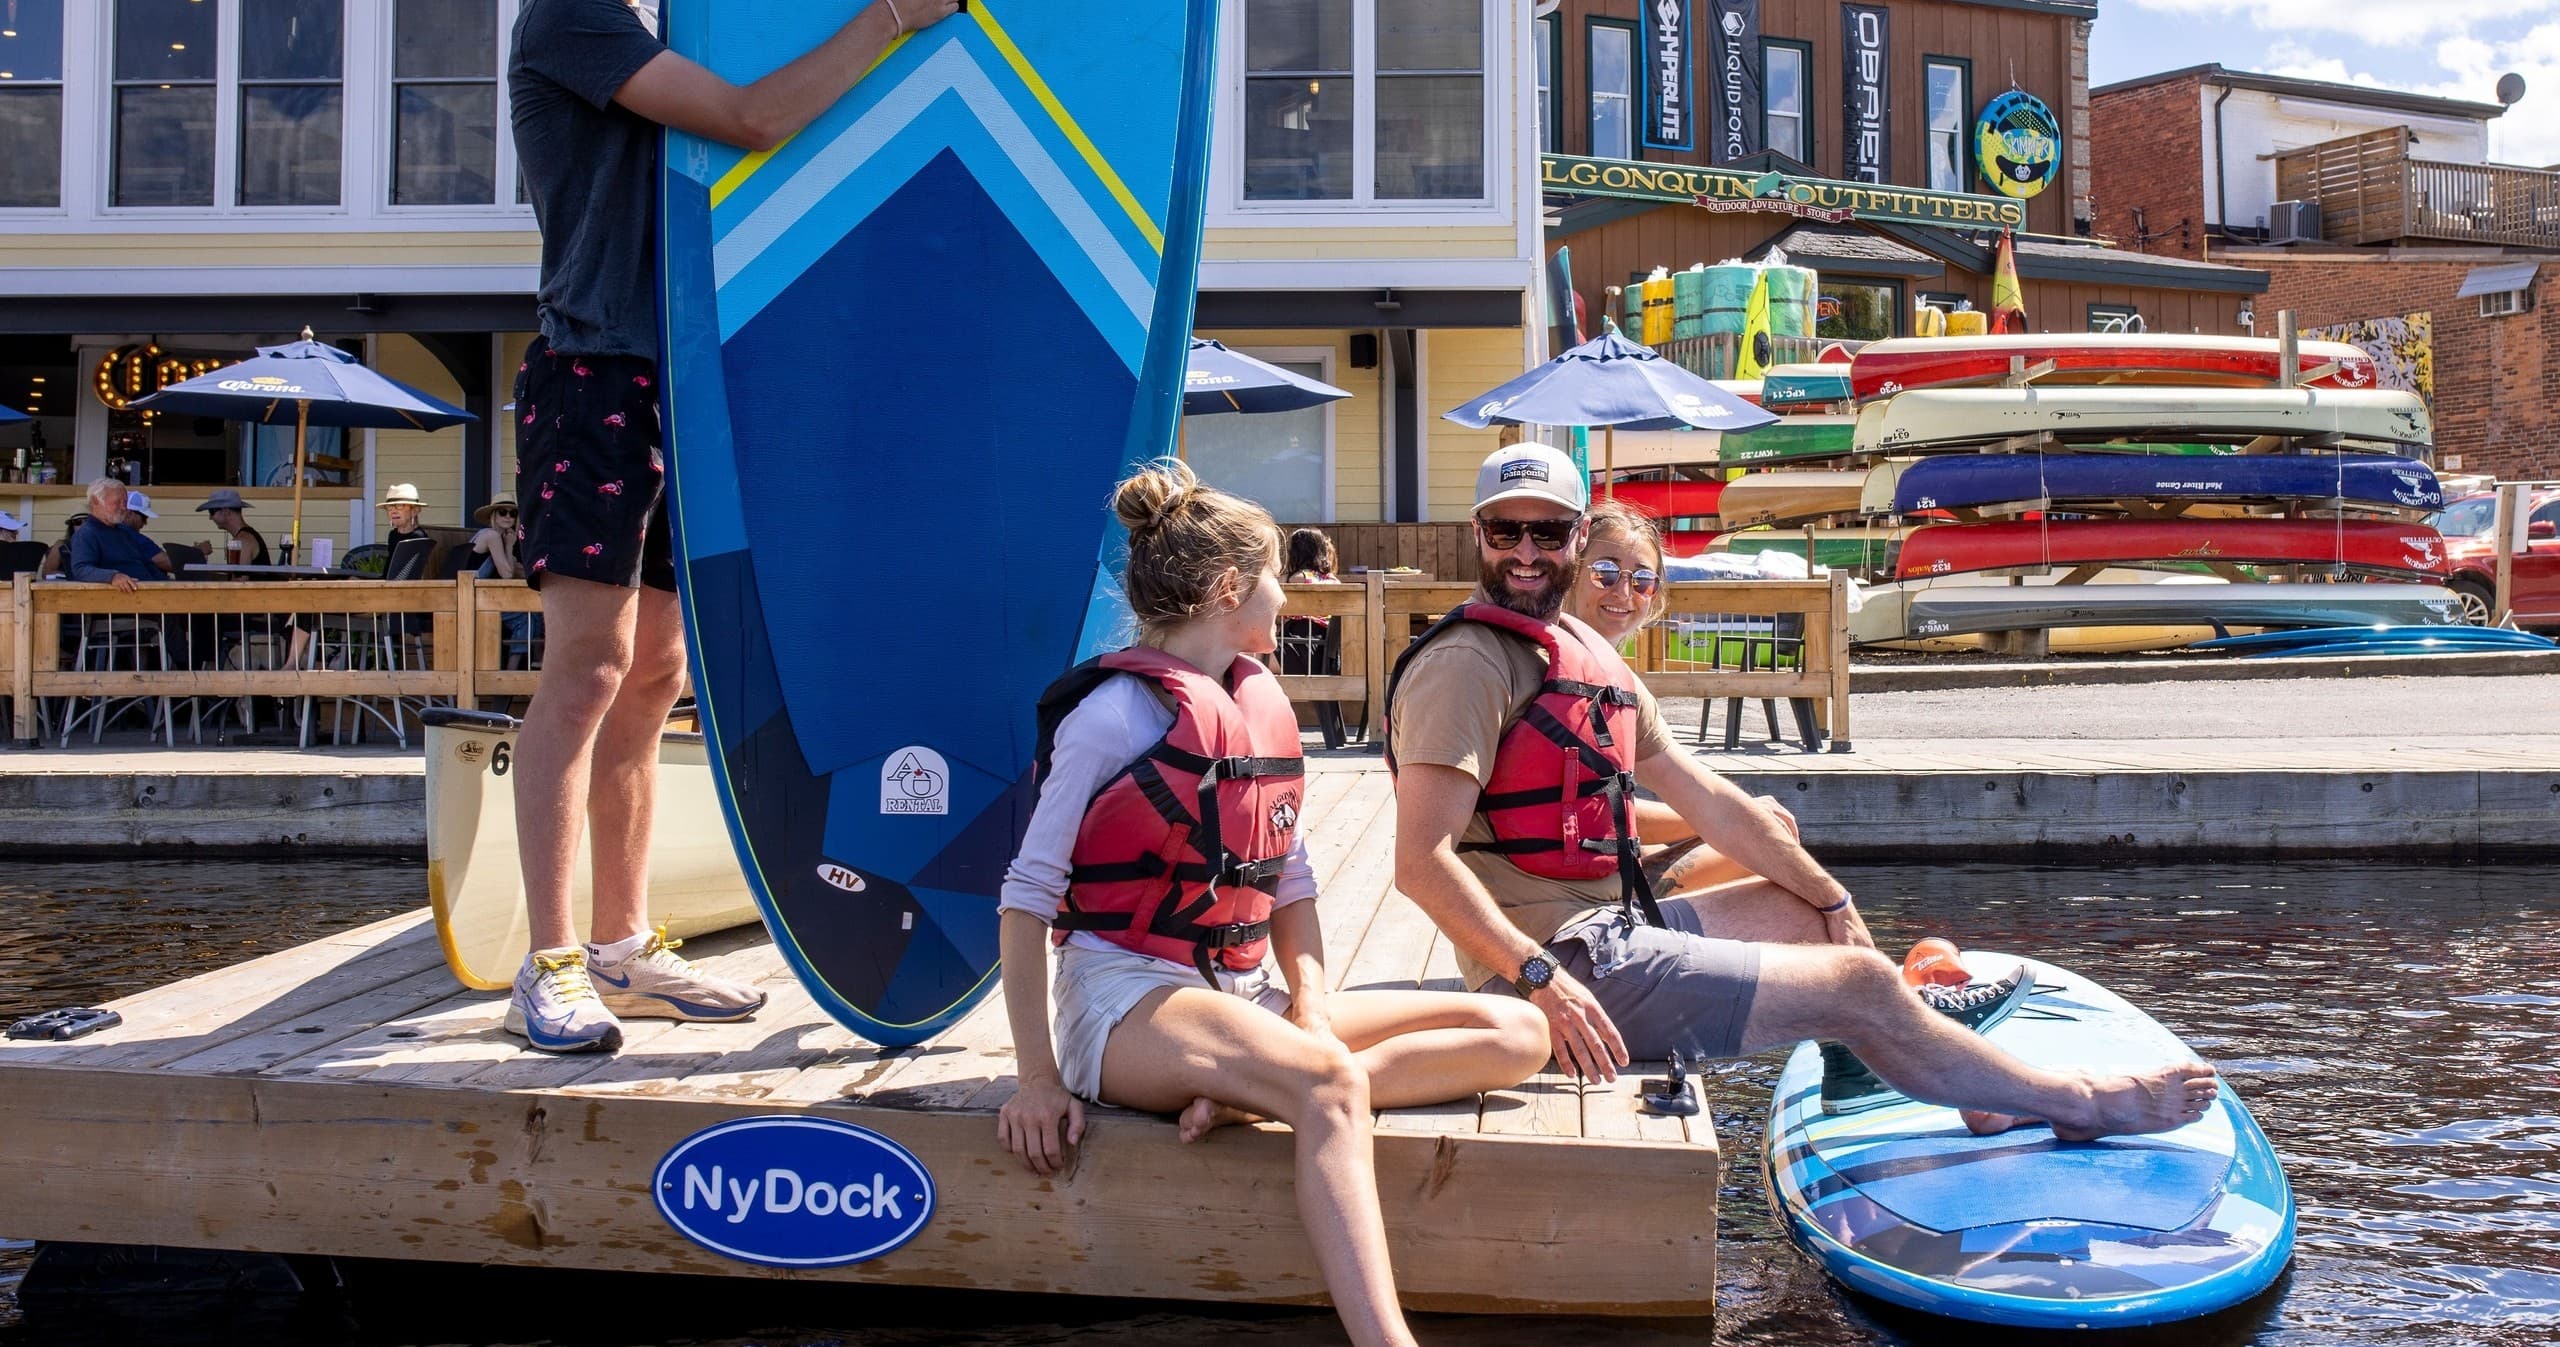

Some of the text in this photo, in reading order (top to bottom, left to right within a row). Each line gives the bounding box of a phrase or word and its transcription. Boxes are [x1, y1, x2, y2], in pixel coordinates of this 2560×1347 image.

[1659, 24, 1680, 140] HYPERLITE
[1726, 42, 1743, 161] LIQUID FORC
[1542, 160, 2022, 224] LGONQUIN OUTFITTERS
[1708, 200, 1831, 221] OUTDOOR ADVENTURE STORE
[2332, 372, 2371, 388] ALGONQUIN
[1879, 383, 1903, 395] FP30
[1740, 448, 1774, 460] KW7.22
[1502, 468, 1547, 481] patagonia
[2155, 481, 2223, 490] Mad River Canoe
[1916, 498, 1936, 510] R21
[1931, 562, 1952, 573] R32
[2402, 554, 2443, 570] ALGONQUIN
[1918, 623, 1950, 634] KW6.6
[886, 798, 943, 813] RENTAL
[827, 867, 861, 889] HV
[684, 1164, 902, 1224] NyDock
